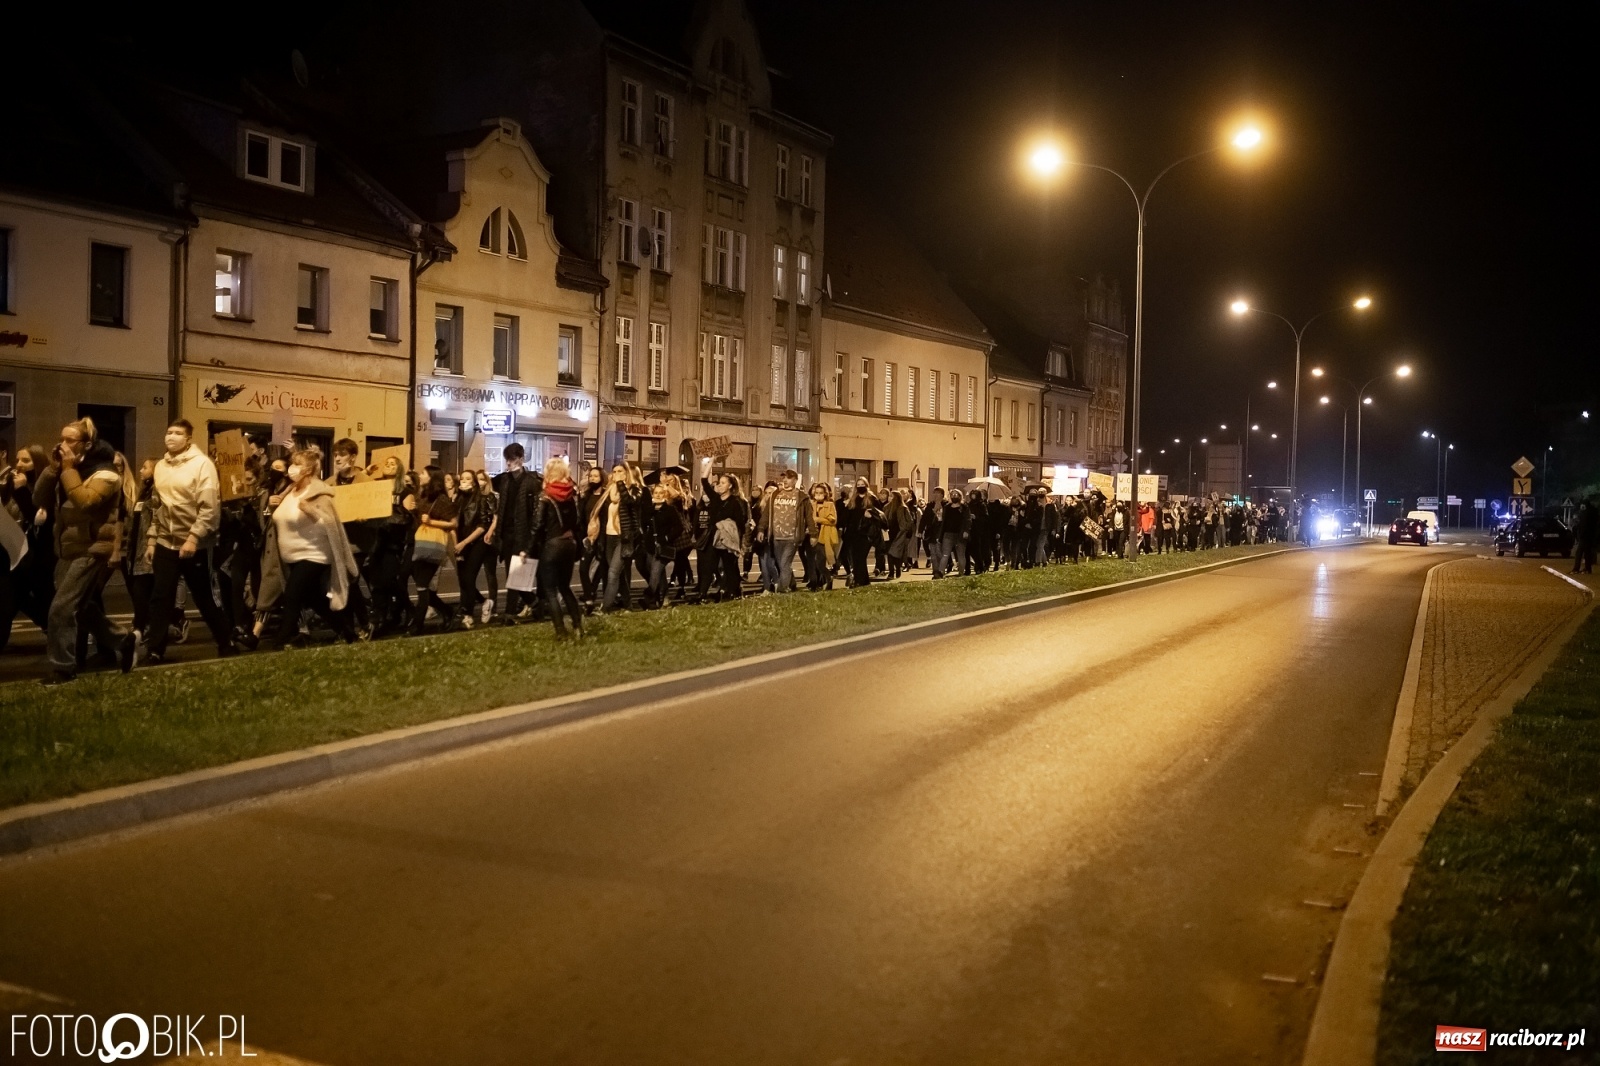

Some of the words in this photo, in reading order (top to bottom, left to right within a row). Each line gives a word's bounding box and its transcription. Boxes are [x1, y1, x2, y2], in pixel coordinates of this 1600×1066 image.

[153, 396, 164, 406] 53
[246, 390, 275, 410] Ani
[278, 391, 329, 412] Ciuszek
[331, 397, 339, 413] 3
[500, 391, 551, 410] NAPRAWA
[1119, 485, 1152, 495] WOLOŚCI
